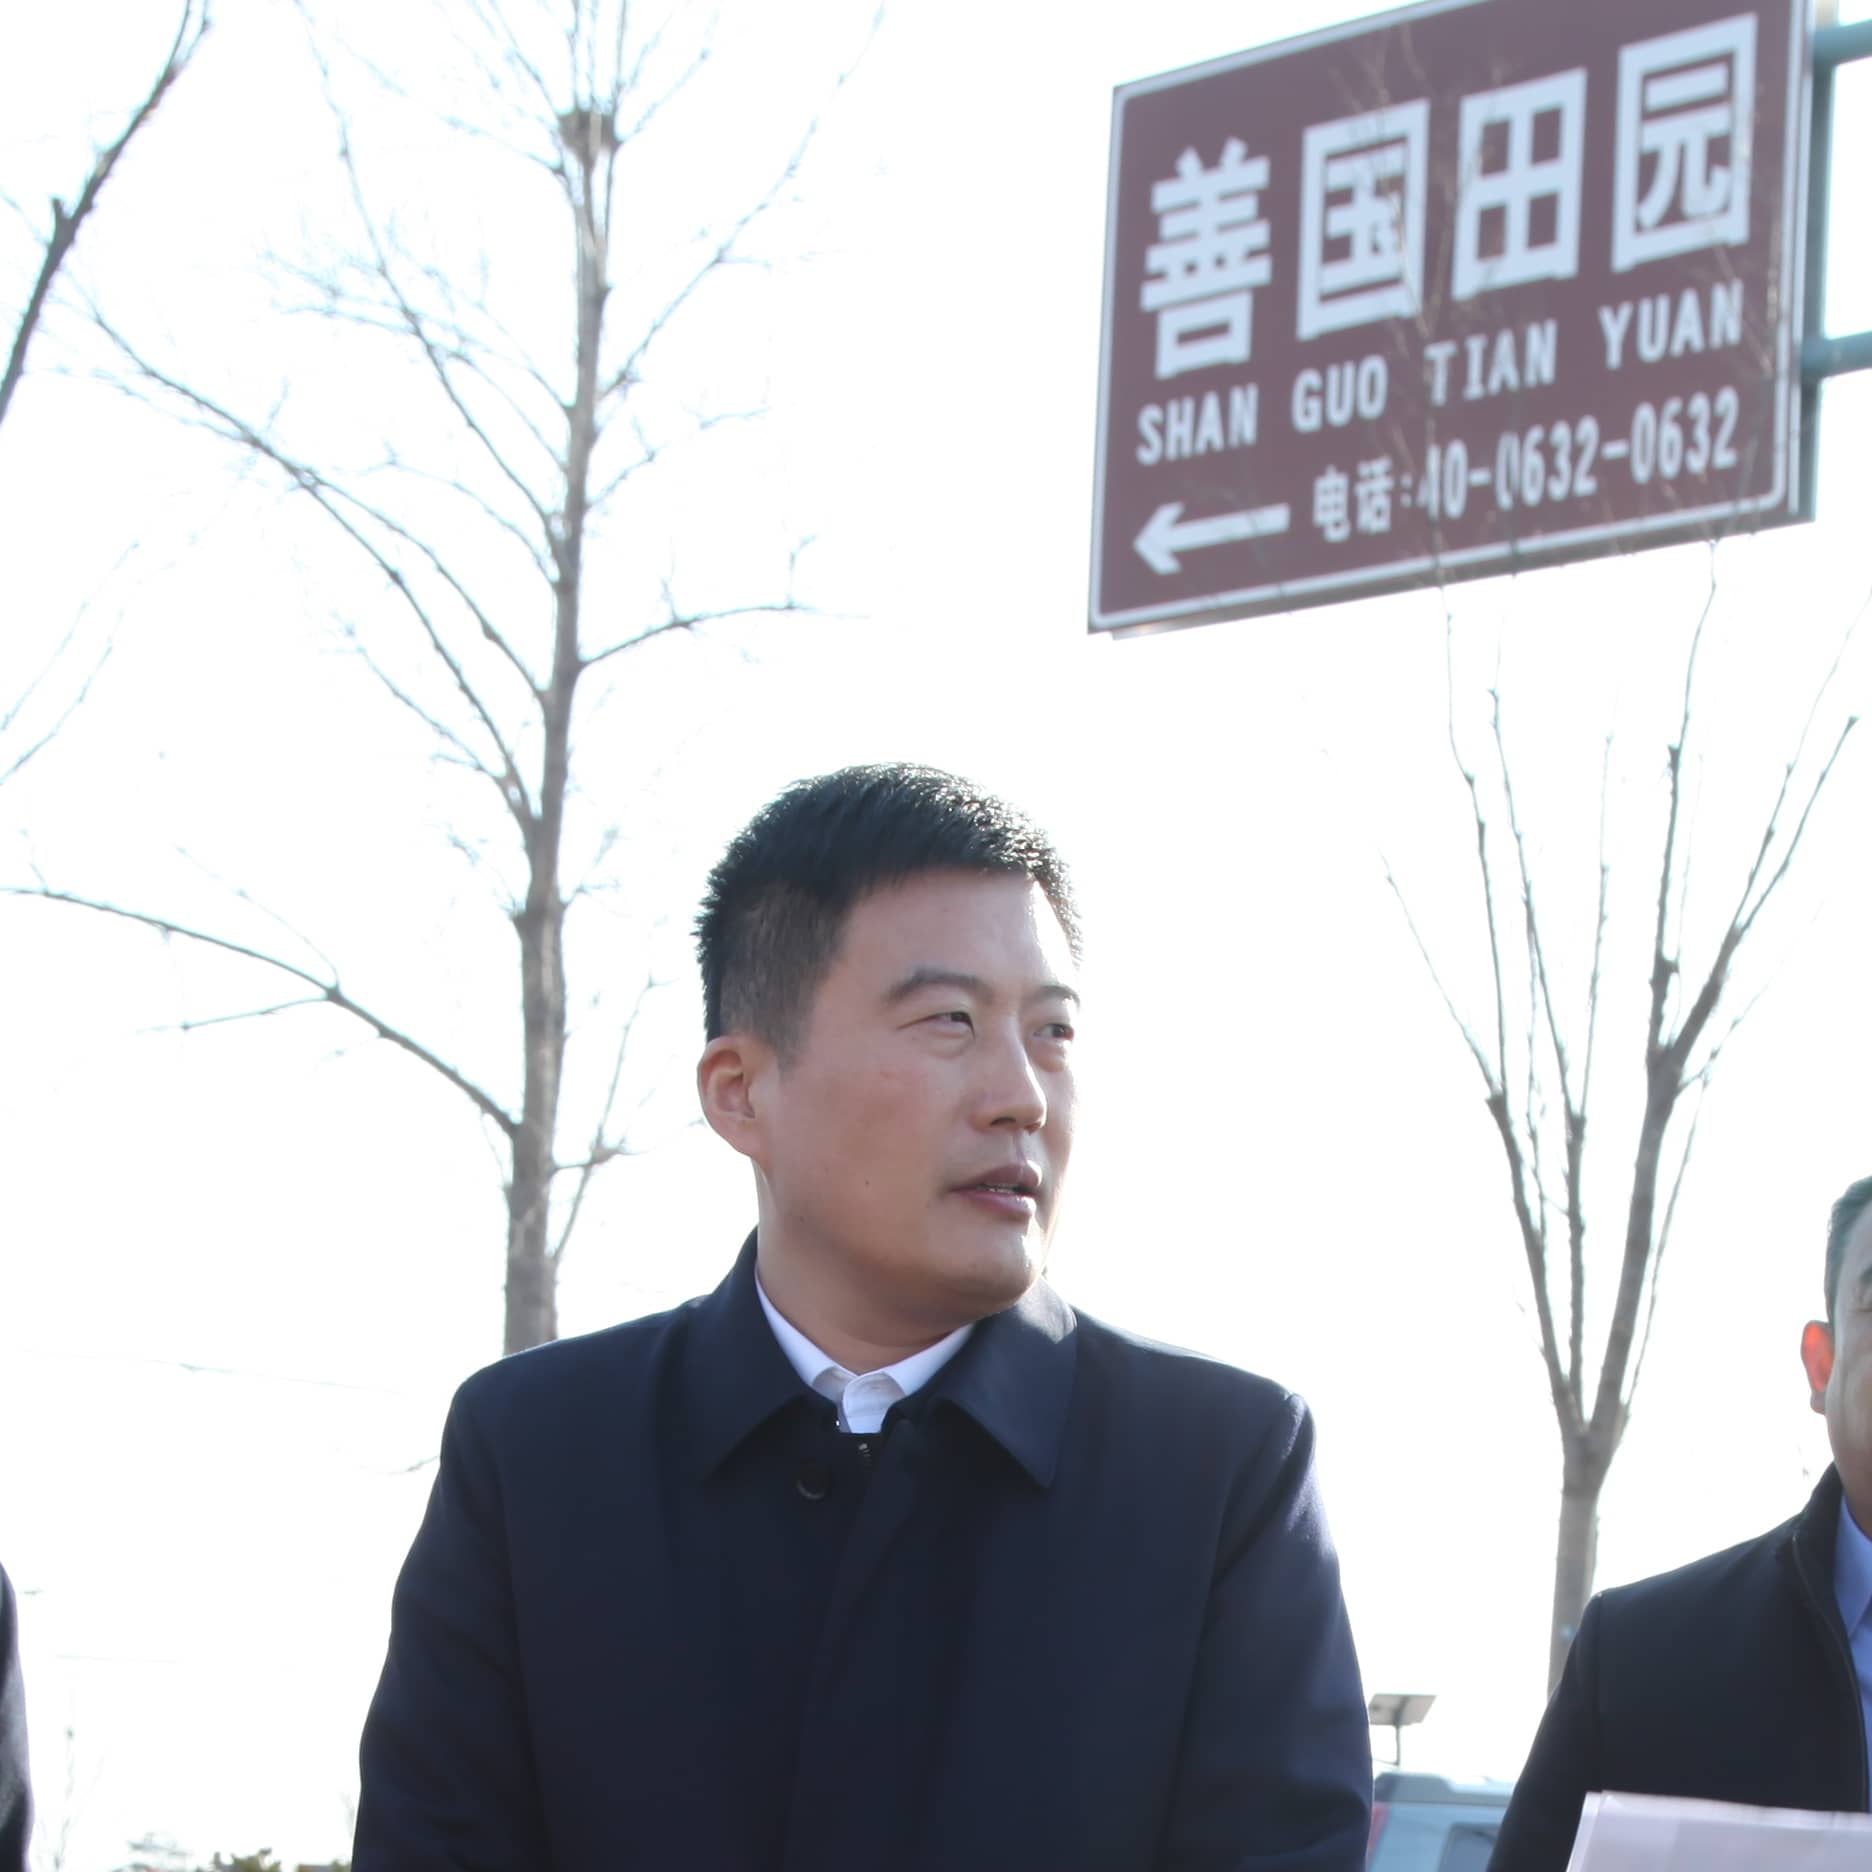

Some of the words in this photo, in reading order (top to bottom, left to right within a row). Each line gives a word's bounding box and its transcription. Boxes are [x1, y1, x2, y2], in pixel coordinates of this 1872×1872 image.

[1140, 13, 1758, 380] 善国田园
[1135, 385, 1258, 466] SHAN
[1292, 356, 1388, 432] GUO
[1425, 321, 1556, 406] TIAN
[1598, 280, 1744, 369] YUAN
